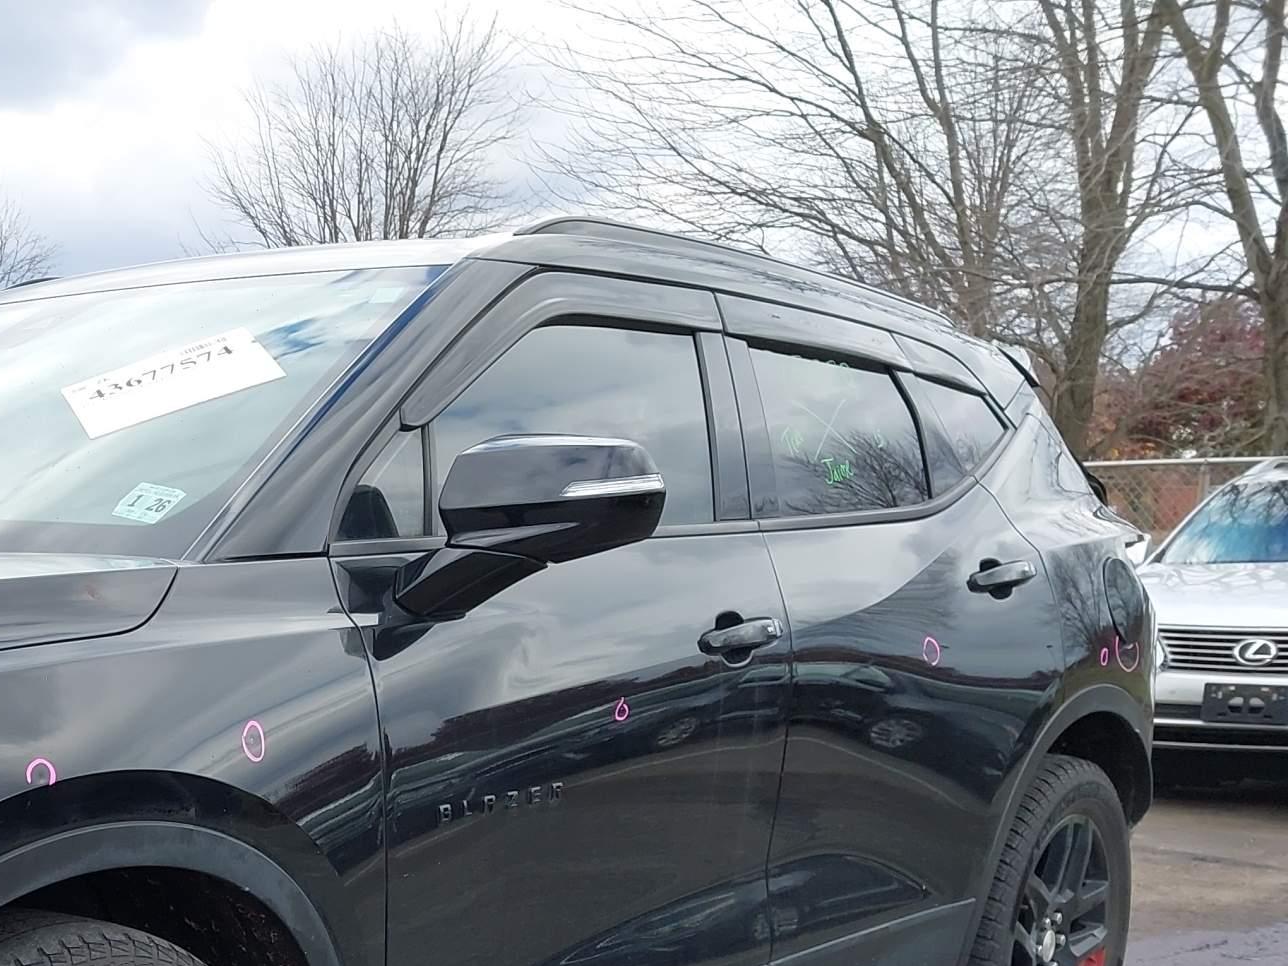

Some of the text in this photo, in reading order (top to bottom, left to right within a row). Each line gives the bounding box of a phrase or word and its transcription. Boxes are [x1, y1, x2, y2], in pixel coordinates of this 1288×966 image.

[88, 345, 235, 401] 43677574
[145, 498, 171, 512] 26
[437, 782, 564, 824] BLAZER
